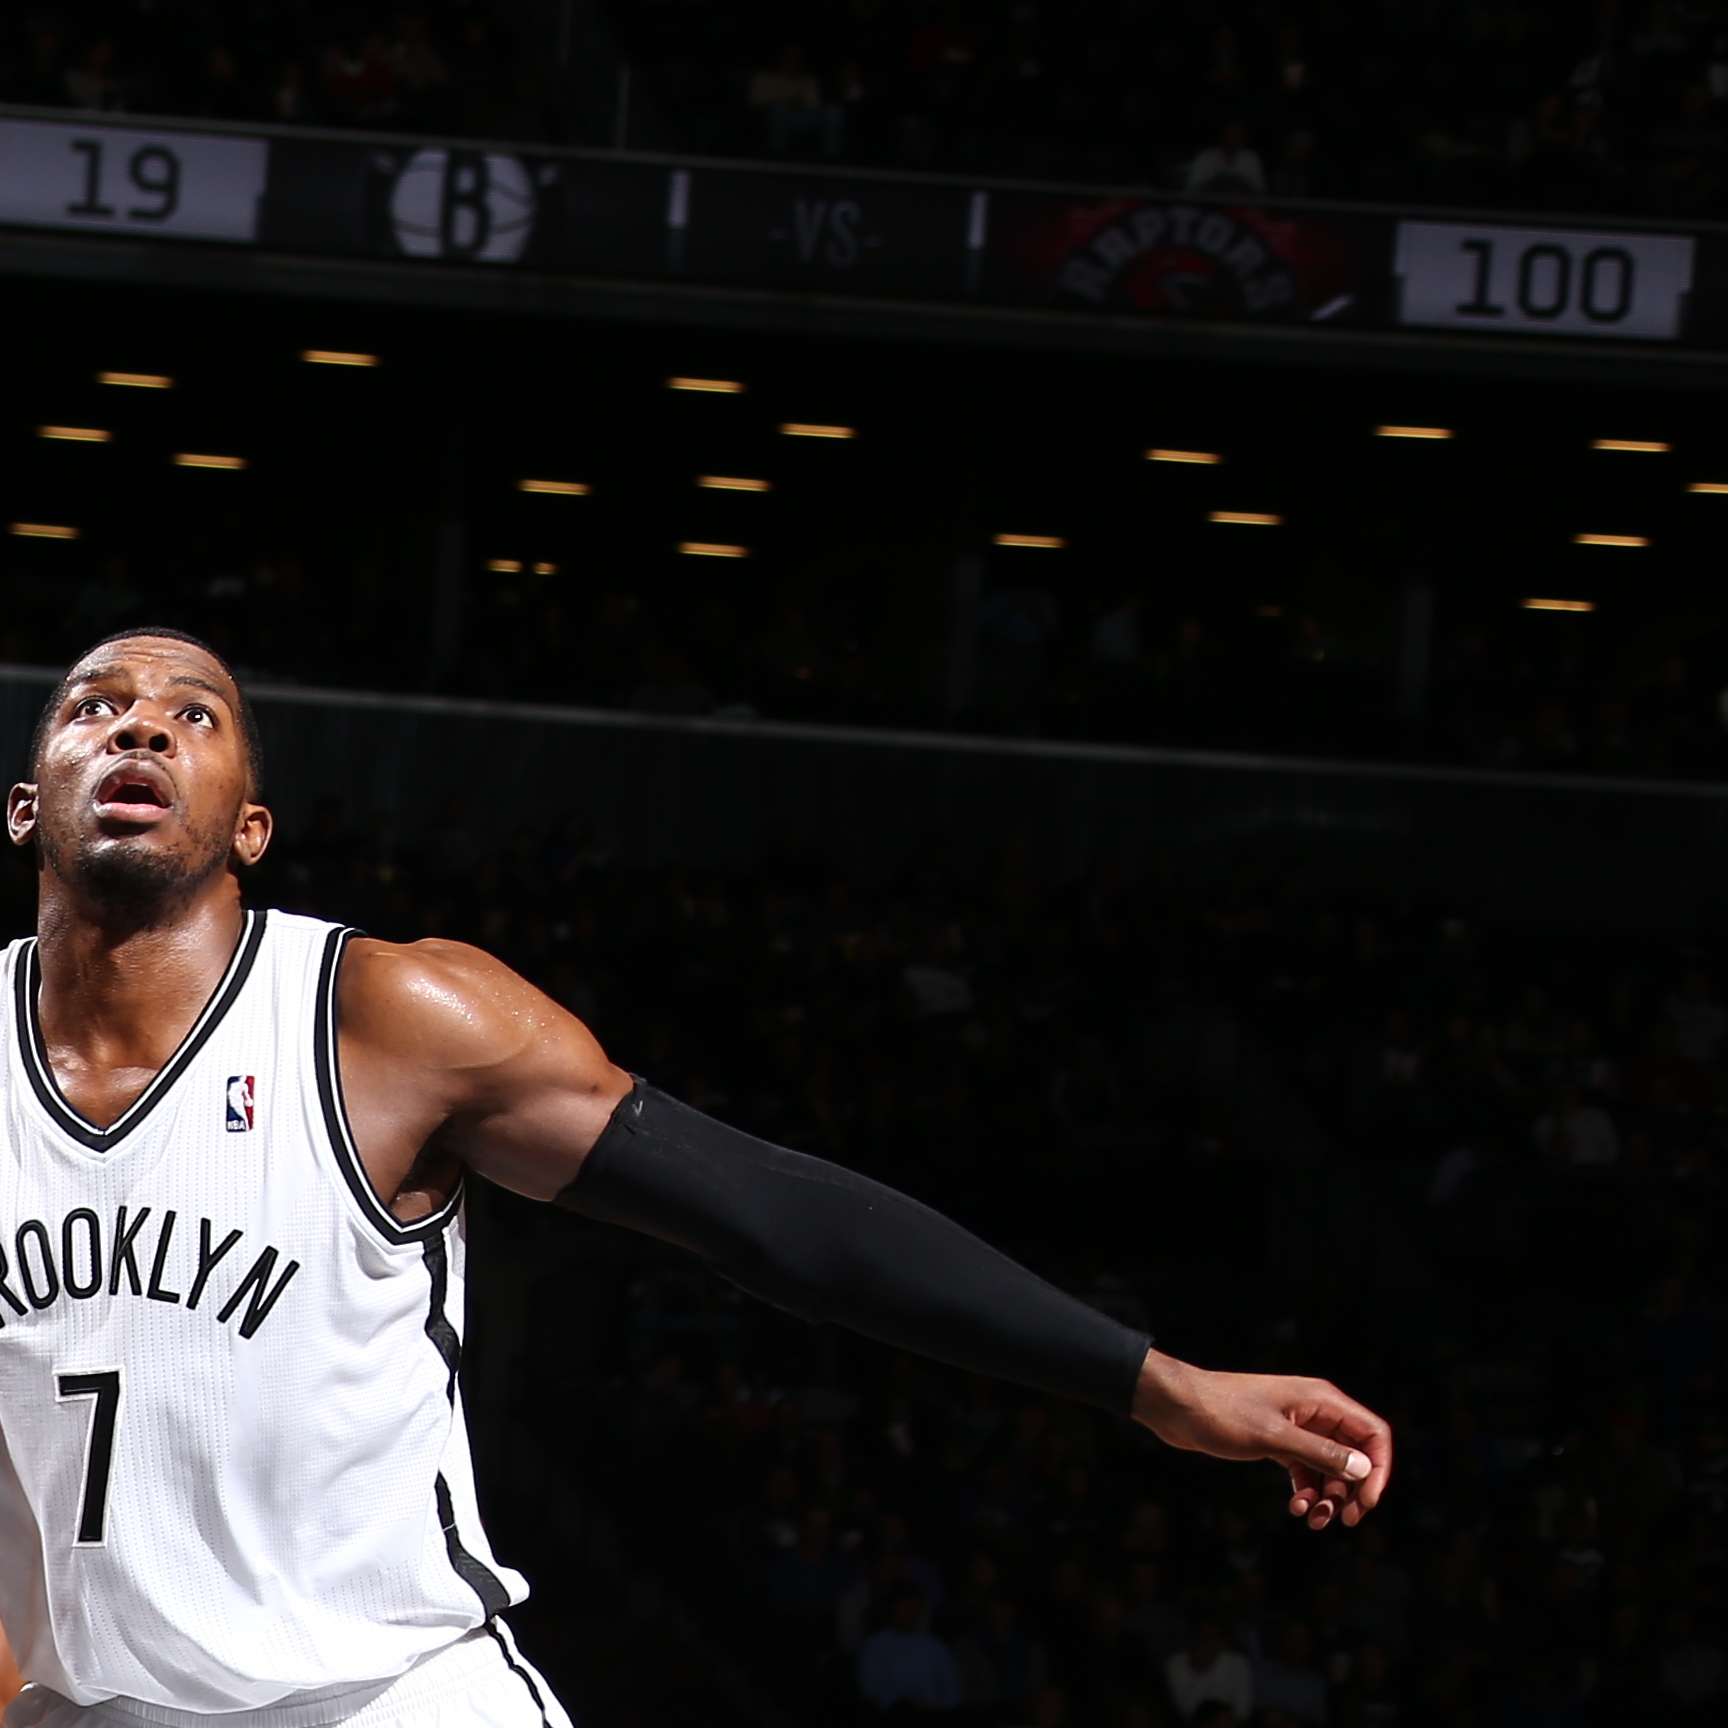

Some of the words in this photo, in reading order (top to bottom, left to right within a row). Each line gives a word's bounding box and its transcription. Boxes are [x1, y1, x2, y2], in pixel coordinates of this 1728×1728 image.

[67, 140, 182, 221] 19
[1456, 238, 1634, 322] 100
[53, 1365, 126, 1548] 7
